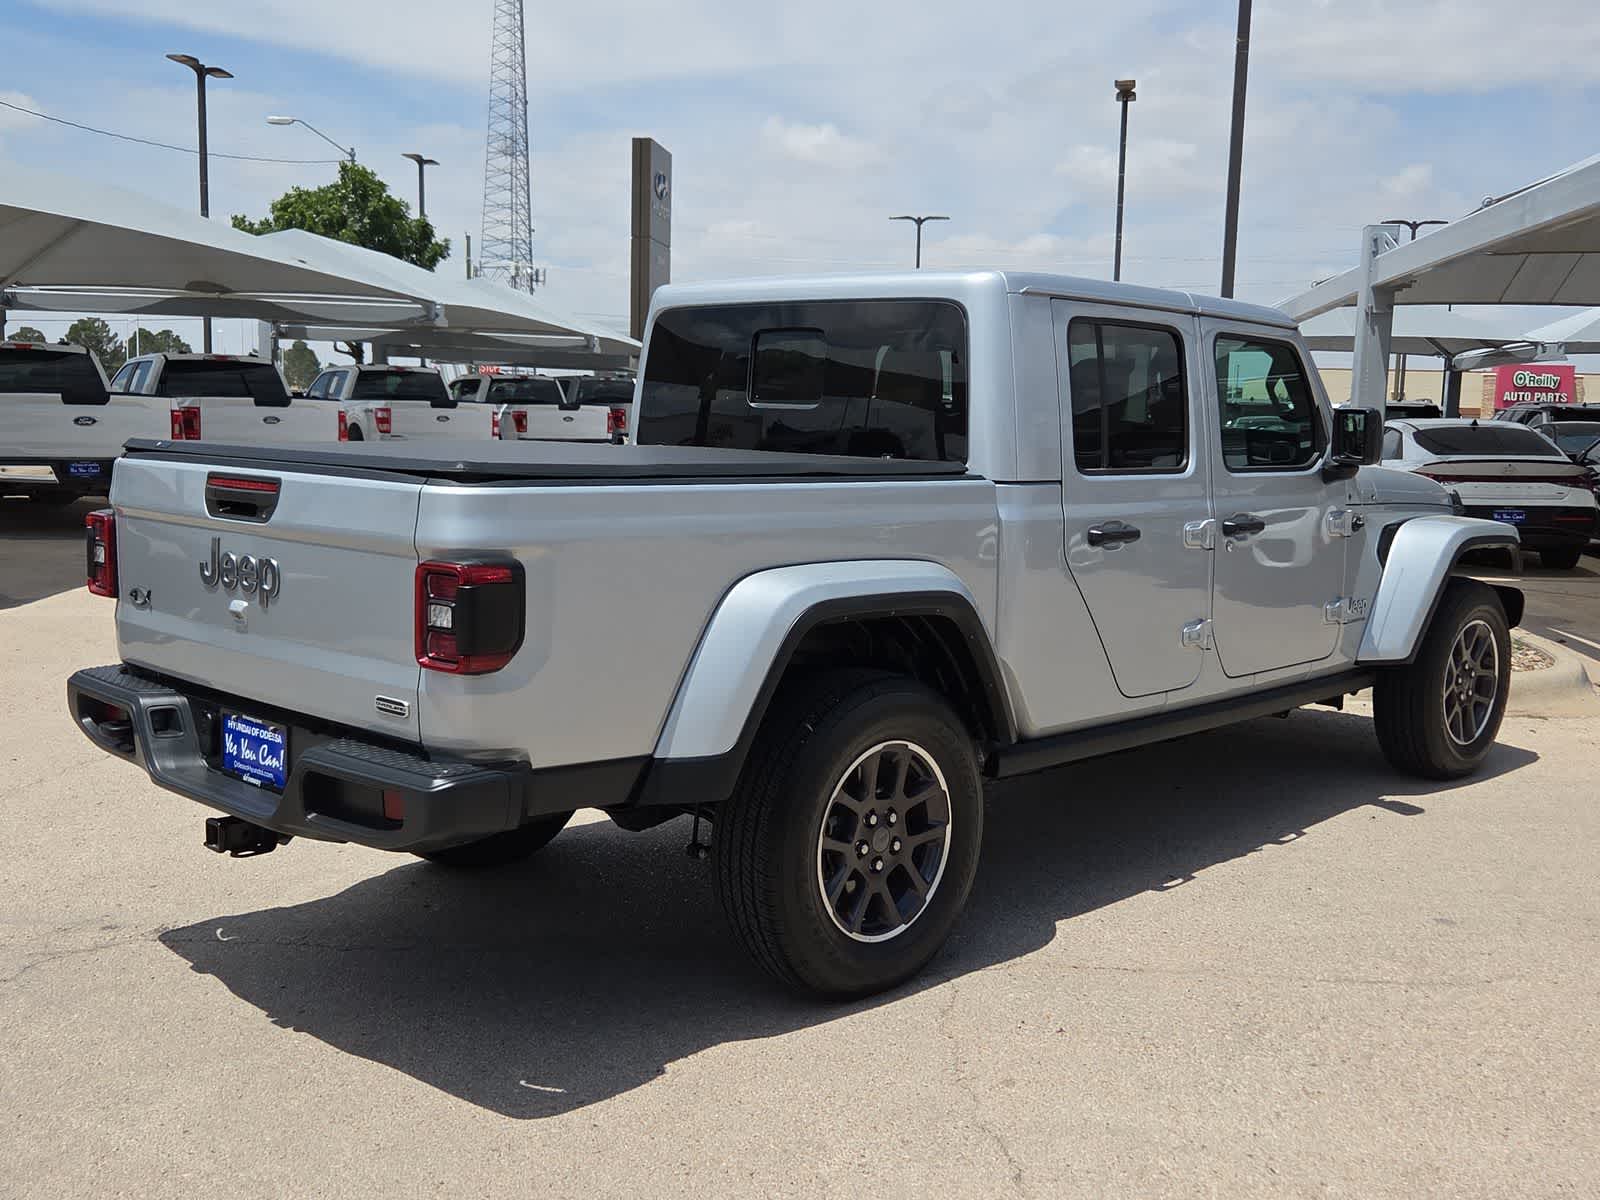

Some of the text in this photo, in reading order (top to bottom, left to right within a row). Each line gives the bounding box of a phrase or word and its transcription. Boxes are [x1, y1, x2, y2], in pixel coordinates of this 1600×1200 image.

[1513, 370, 1560, 389] O'Reilly
[1503, 391, 1568, 402] AUTO PARTS
[200, 536, 280, 608] Jeep
[1346, 597, 1367, 615] Jeep
[227, 719, 252, 735] HYUNDAI
[251, 727, 260, 737] OF
[225, 733, 284, 771] Yes You Can!
